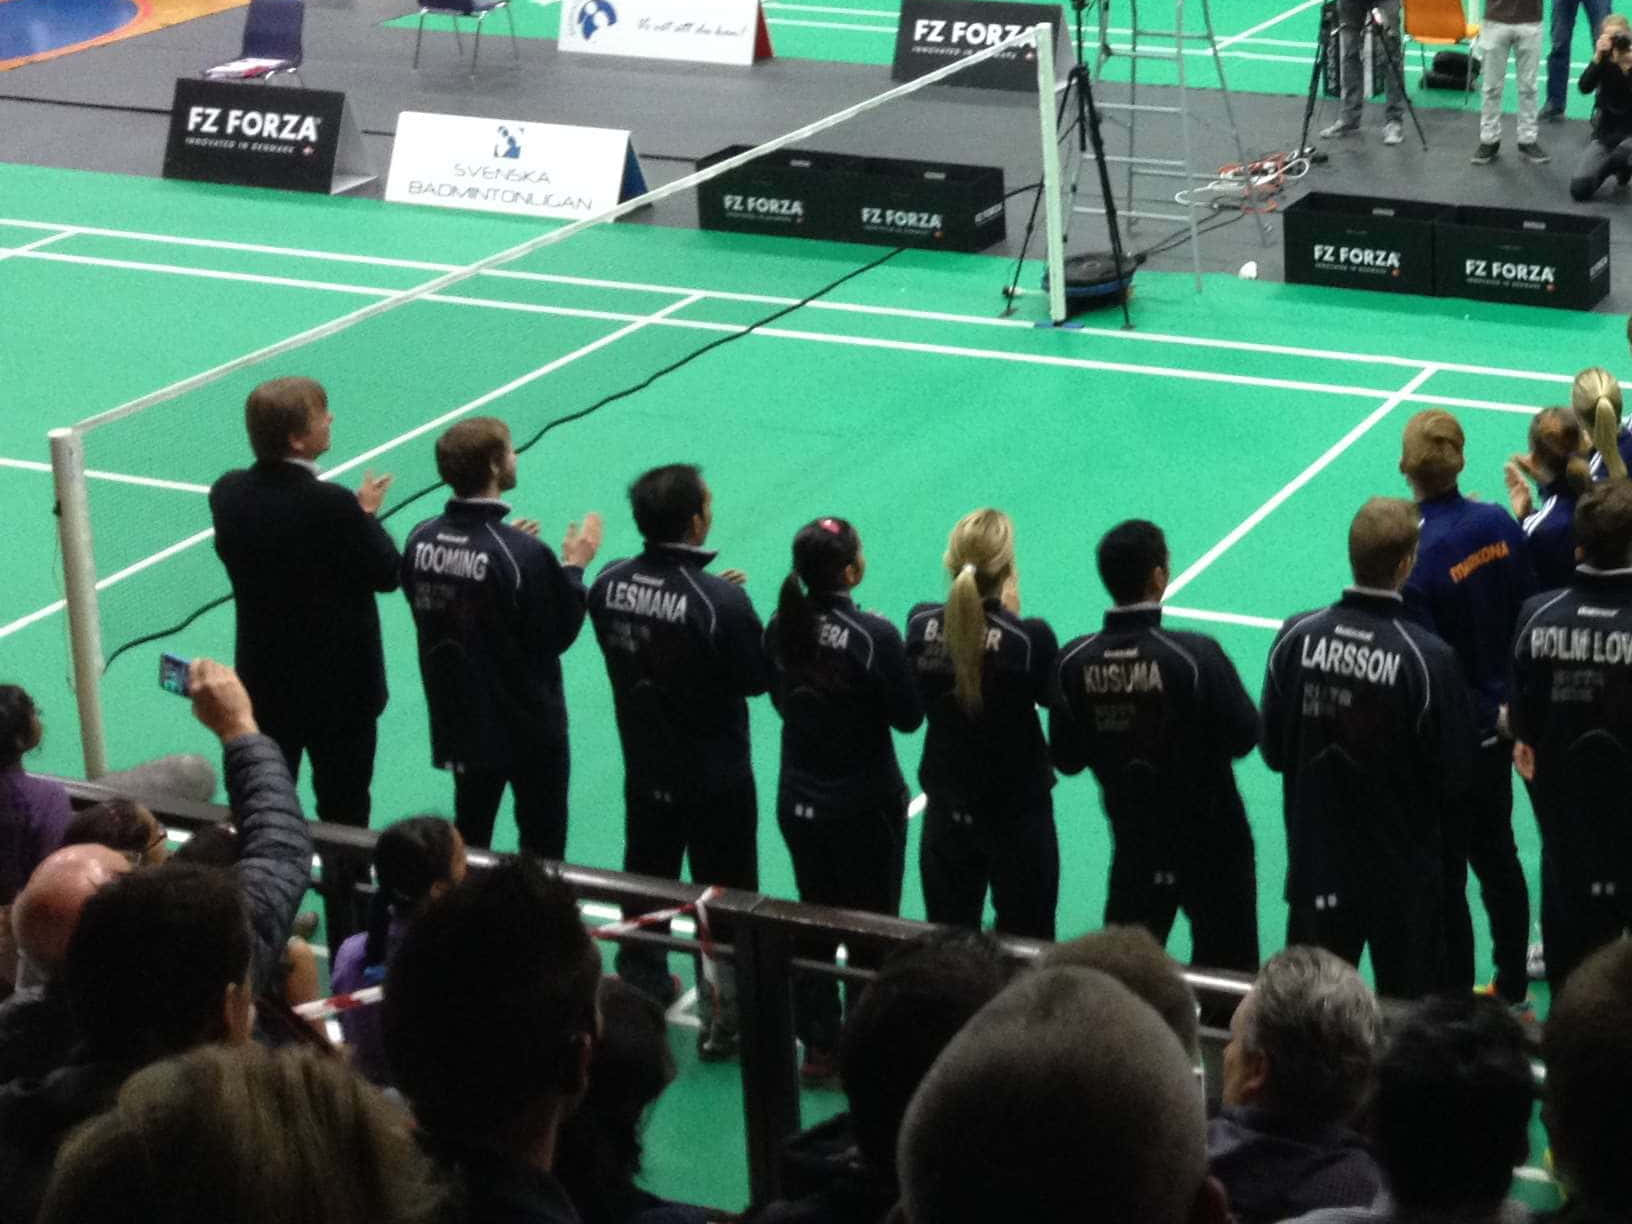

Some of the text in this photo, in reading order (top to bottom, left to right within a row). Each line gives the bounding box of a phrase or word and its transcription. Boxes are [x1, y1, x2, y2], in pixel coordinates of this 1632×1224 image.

[914, 19, 947, 43] FZ
[187, 106, 319, 142] FZ FORZA
[453, 163, 551, 185] SVENSKA
[408, 180, 592, 211] BADMINTONLIGAN
[723, 195, 804, 216] FZ FORZA
[861, 207, 942, 228] FZ FORZA
[1313, 244, 1400, 268] FZ FORZA
[1465, 259, 1554, 283] FZ FORZA
[413, 541, 490, 581] TOOMING
[604, 580, 689, 624] LESMANA
[1530, 626, 1591, 660] HOLM
[1301, 634, 1401, 686] LARSSON
